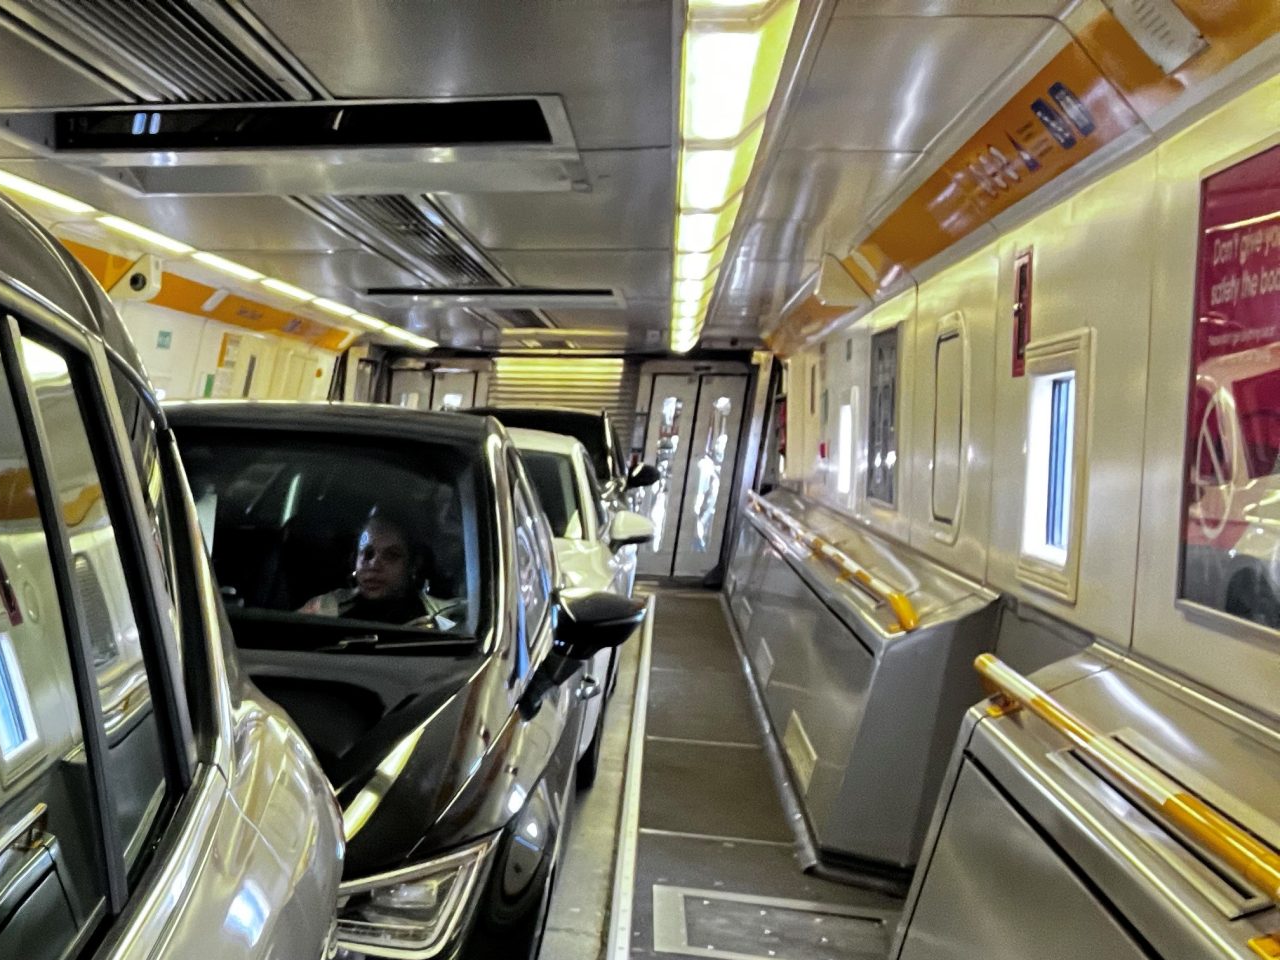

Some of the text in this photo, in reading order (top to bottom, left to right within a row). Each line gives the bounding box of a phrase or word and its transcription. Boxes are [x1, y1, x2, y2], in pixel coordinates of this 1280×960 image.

[1213, 232, 1240, 267] Don't
[1240, 227, 1263, 264] give
[1240, 269, 1258, 300] the
